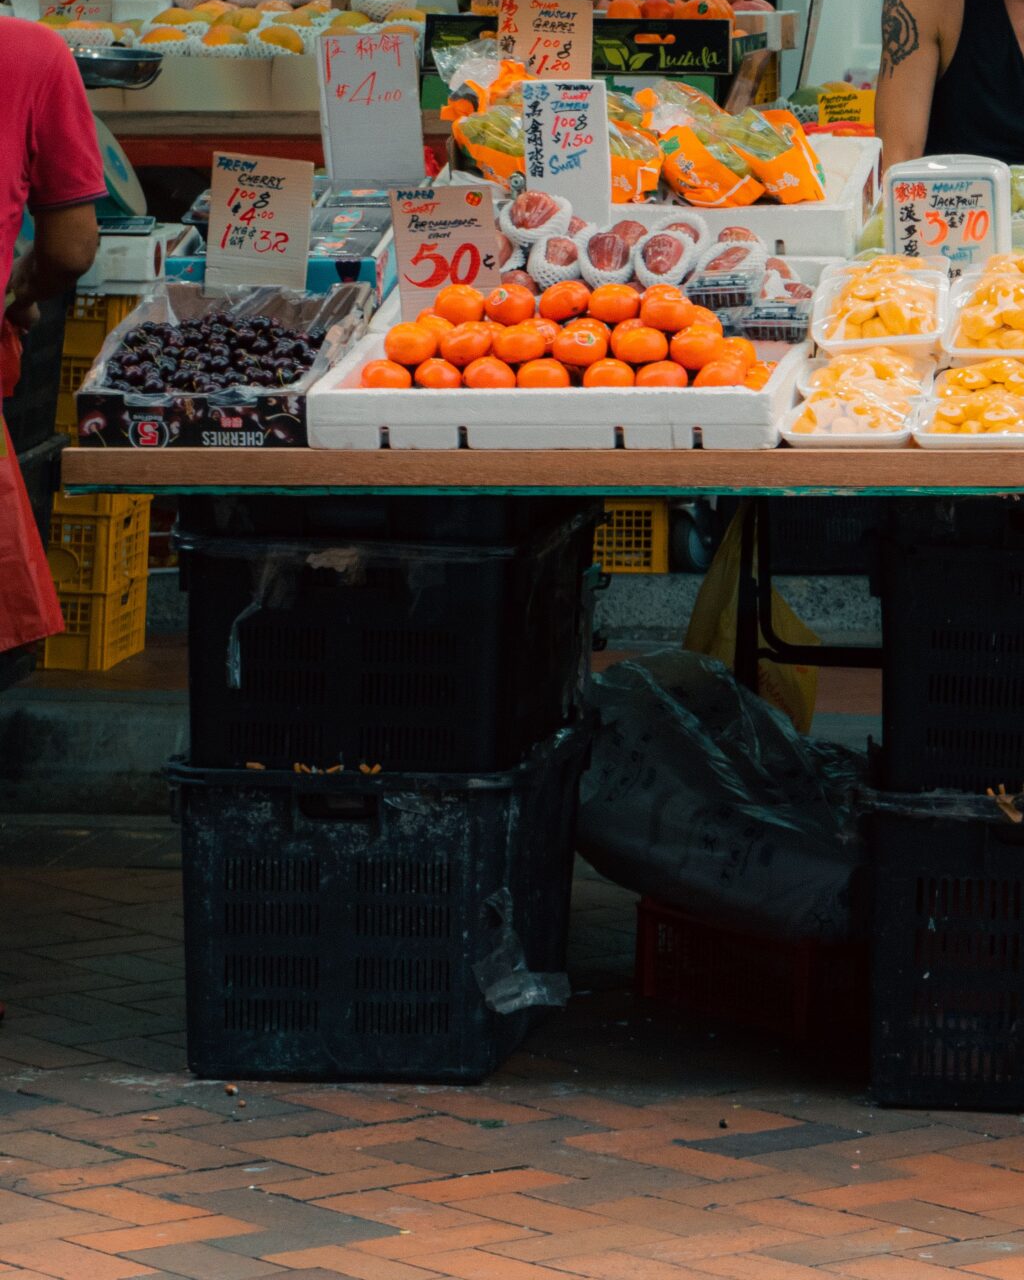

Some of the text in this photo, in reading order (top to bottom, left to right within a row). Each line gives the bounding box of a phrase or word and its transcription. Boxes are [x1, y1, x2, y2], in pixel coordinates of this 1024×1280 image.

[539, 9, 577, 20] MUSCAT
[532, 18, 575, 32] GRAPES
[238, 173, 286, 189] CHERRY
[396, 189, 434, 200] KOREA
[930, 193, 983, 208] JACKFRUIT
[920, 211, 948, 246] 3
[137, 420, 158, 446] 5
[201, 430, 263, 446] CHERRIES
